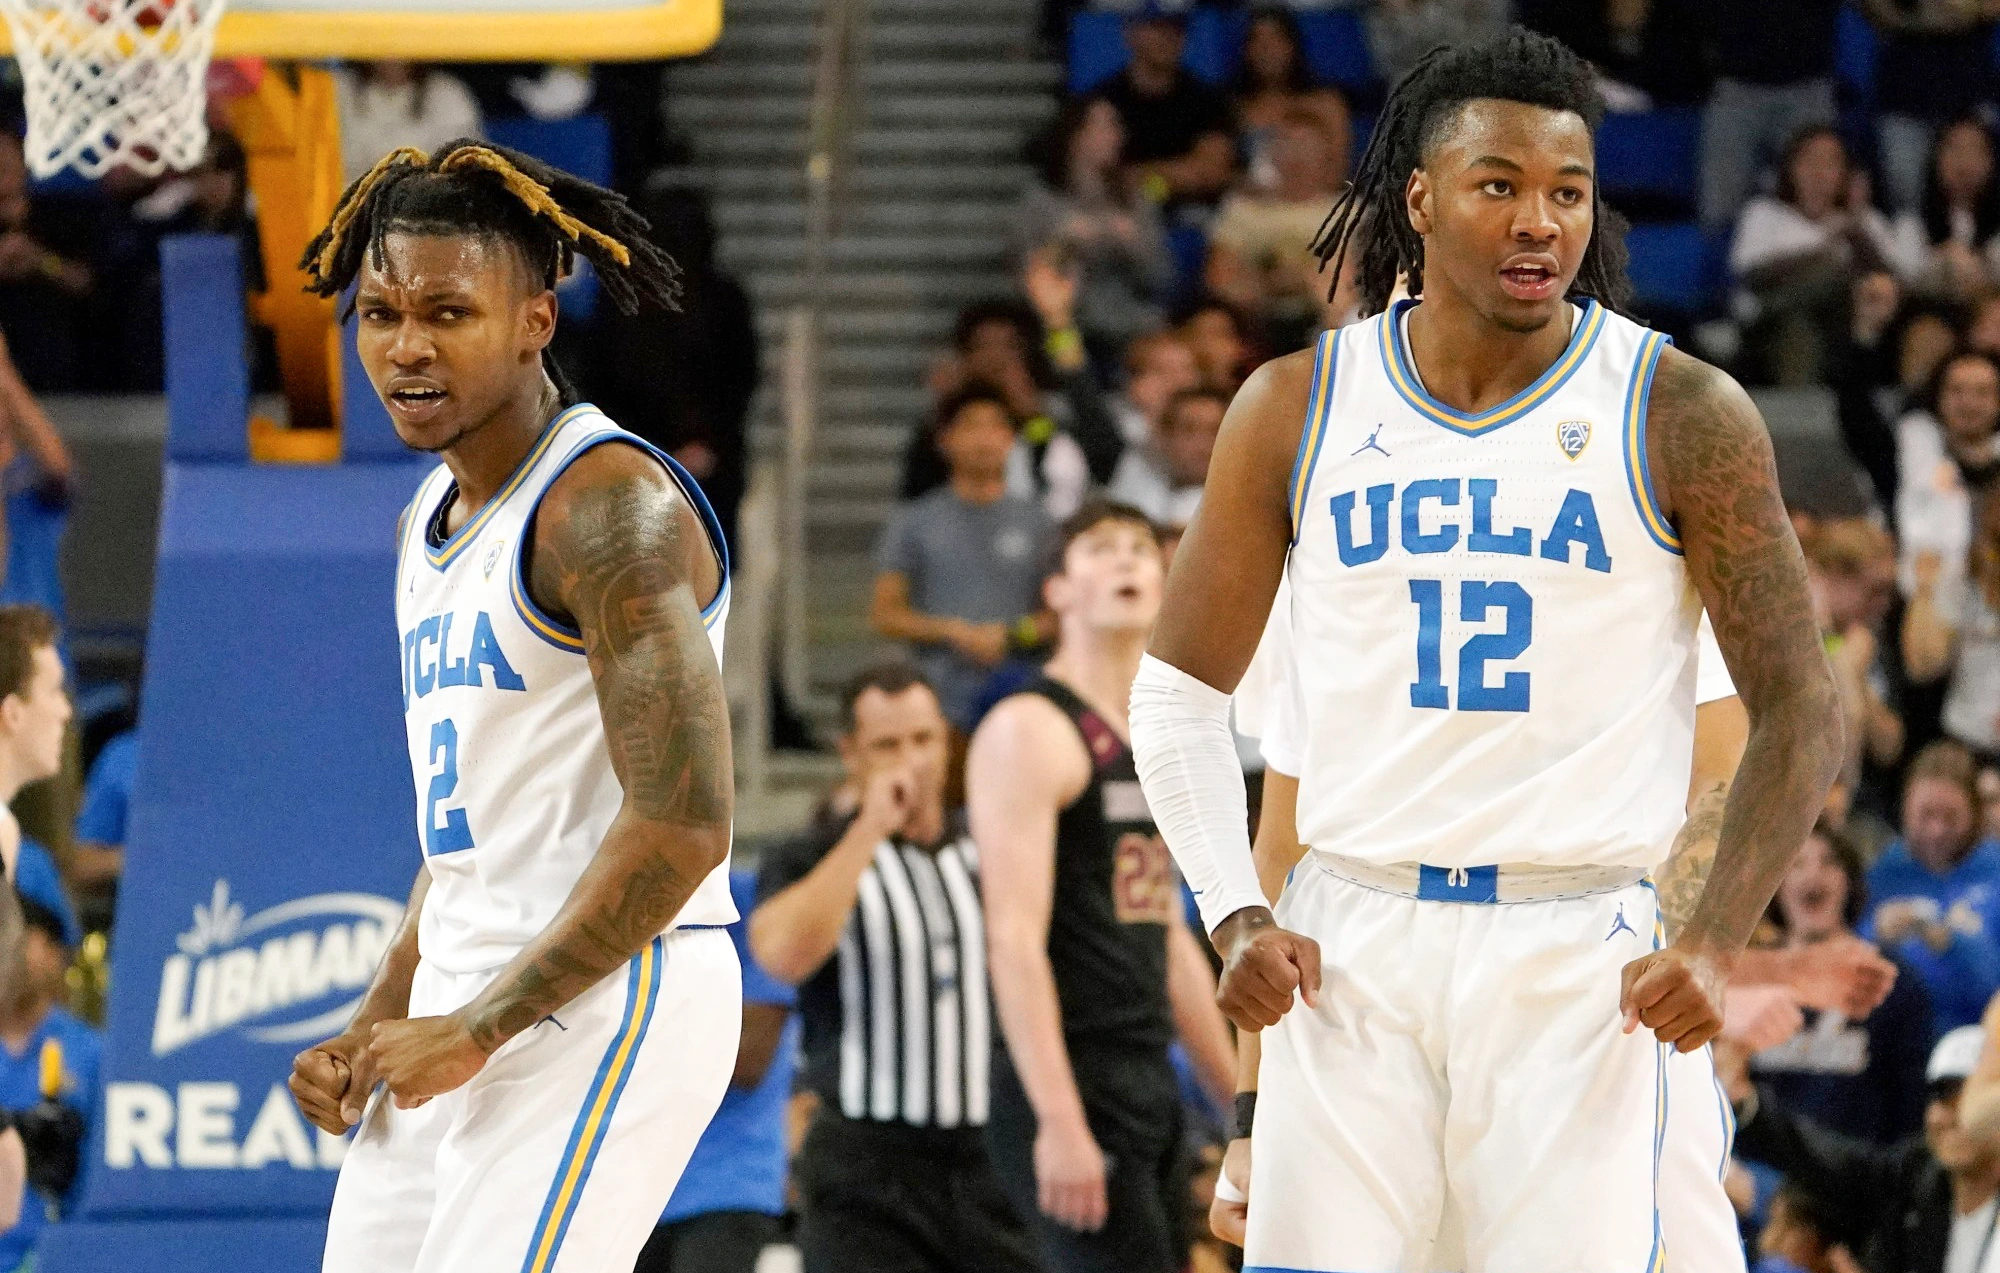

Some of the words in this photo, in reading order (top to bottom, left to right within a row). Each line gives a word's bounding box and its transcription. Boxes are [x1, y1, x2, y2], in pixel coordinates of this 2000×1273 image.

[1558, 421, 1590, 443] PAC
[1564, 437, 1582, 451] 12
[1330, 478, 1612, 573] UCLA
[1409, 579, 1533, 712] 12
[427, 718, 475, 856] 2
[152, 920, 393, 1057] LIBMAN
